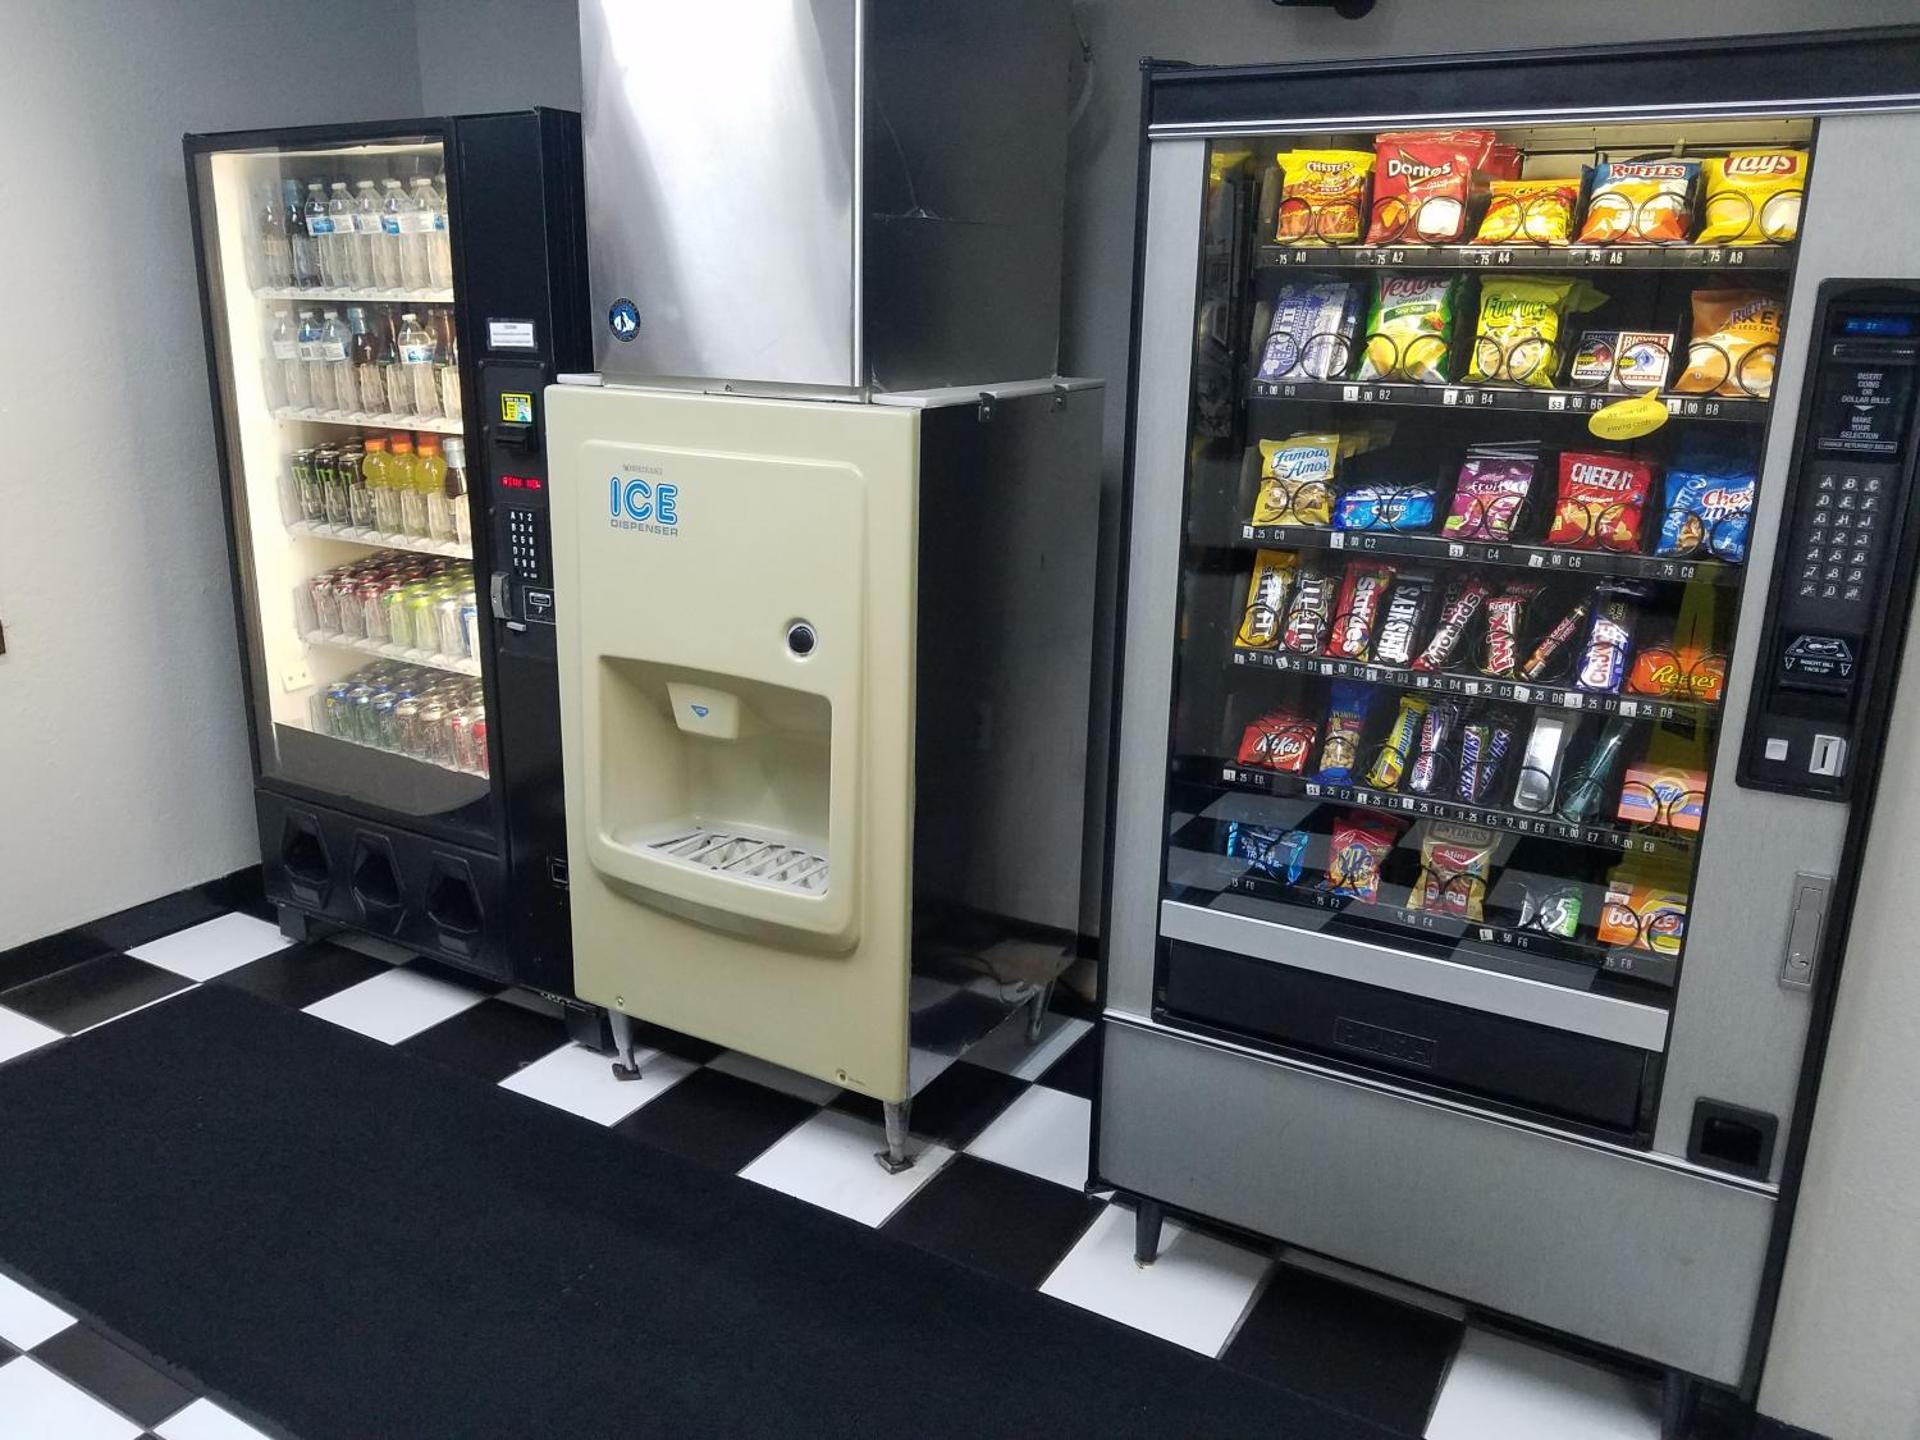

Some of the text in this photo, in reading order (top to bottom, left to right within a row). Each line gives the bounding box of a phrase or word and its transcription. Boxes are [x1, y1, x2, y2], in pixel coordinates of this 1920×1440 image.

[1387, 158, 1452, 178] Doritos
[1609, 163, 1685, 179] RUFFLES
[1392, 252, 1403, 263] A2
[1497, 252, 1510, 263] A4
[1609, 252, 1622, 264] A6
[1729, 252, 1743, 264] A8
[1857, 372, 1883, 381] INSERT
[1857, 380, 1880, 389] COINS
[1378, 389, 1391, 401] B2
[1480, 393, 1493, 404] B4
[1841, 396, 1891, 405] DOLLAR BILLS
[1590, 398, 1602, 410] B6
[1705, 402, 1719, 415] B8
[1852, 416, 1873, 424] MAKE
[1851, 423, 1871, 432] YOUR
[1840, 430, 1879, 440] SELECTION
[1271, 449, 1330, 469] Famous
[1283, 461, 1329, 479] Amos
[610, 477, 678, 525] ICE
[1702, 487, 1754, 508] Chex
[610, 519, 679, 537] DISPENSER
[1364, 538, 1376, 549] C2
[1487, 549, 1499, 560] C4
[1568, 557, 1581, 568] C6
[1681, 567, 1694, 578] C8
[1377, 586, 1421, 663] HERSHEY'S
[1353, 665, 1364, 677] D2
[1449, 679, 1460, 690] D4
[1499, 685, 1511, 696] D5
[1551, 690, 1563, 703] D6
[1604, 699, 1617, 711] D7
[1340, 789, 1349, 800] E2
[1654, 785, 1683, 803] Tide
[1433, 805, 1443, 816] E4
[1486, 814, 1497, 825] E5
[1534, 823, 1545, 834] E6
[1587, 832, 1598, 843] E7
[1643, 842, 1655, 853] E8
[1444, 849, 1467, 861] Mini
[1330, 897, 1340, 908] F2
[1516, 938, 1528, 948] F6
